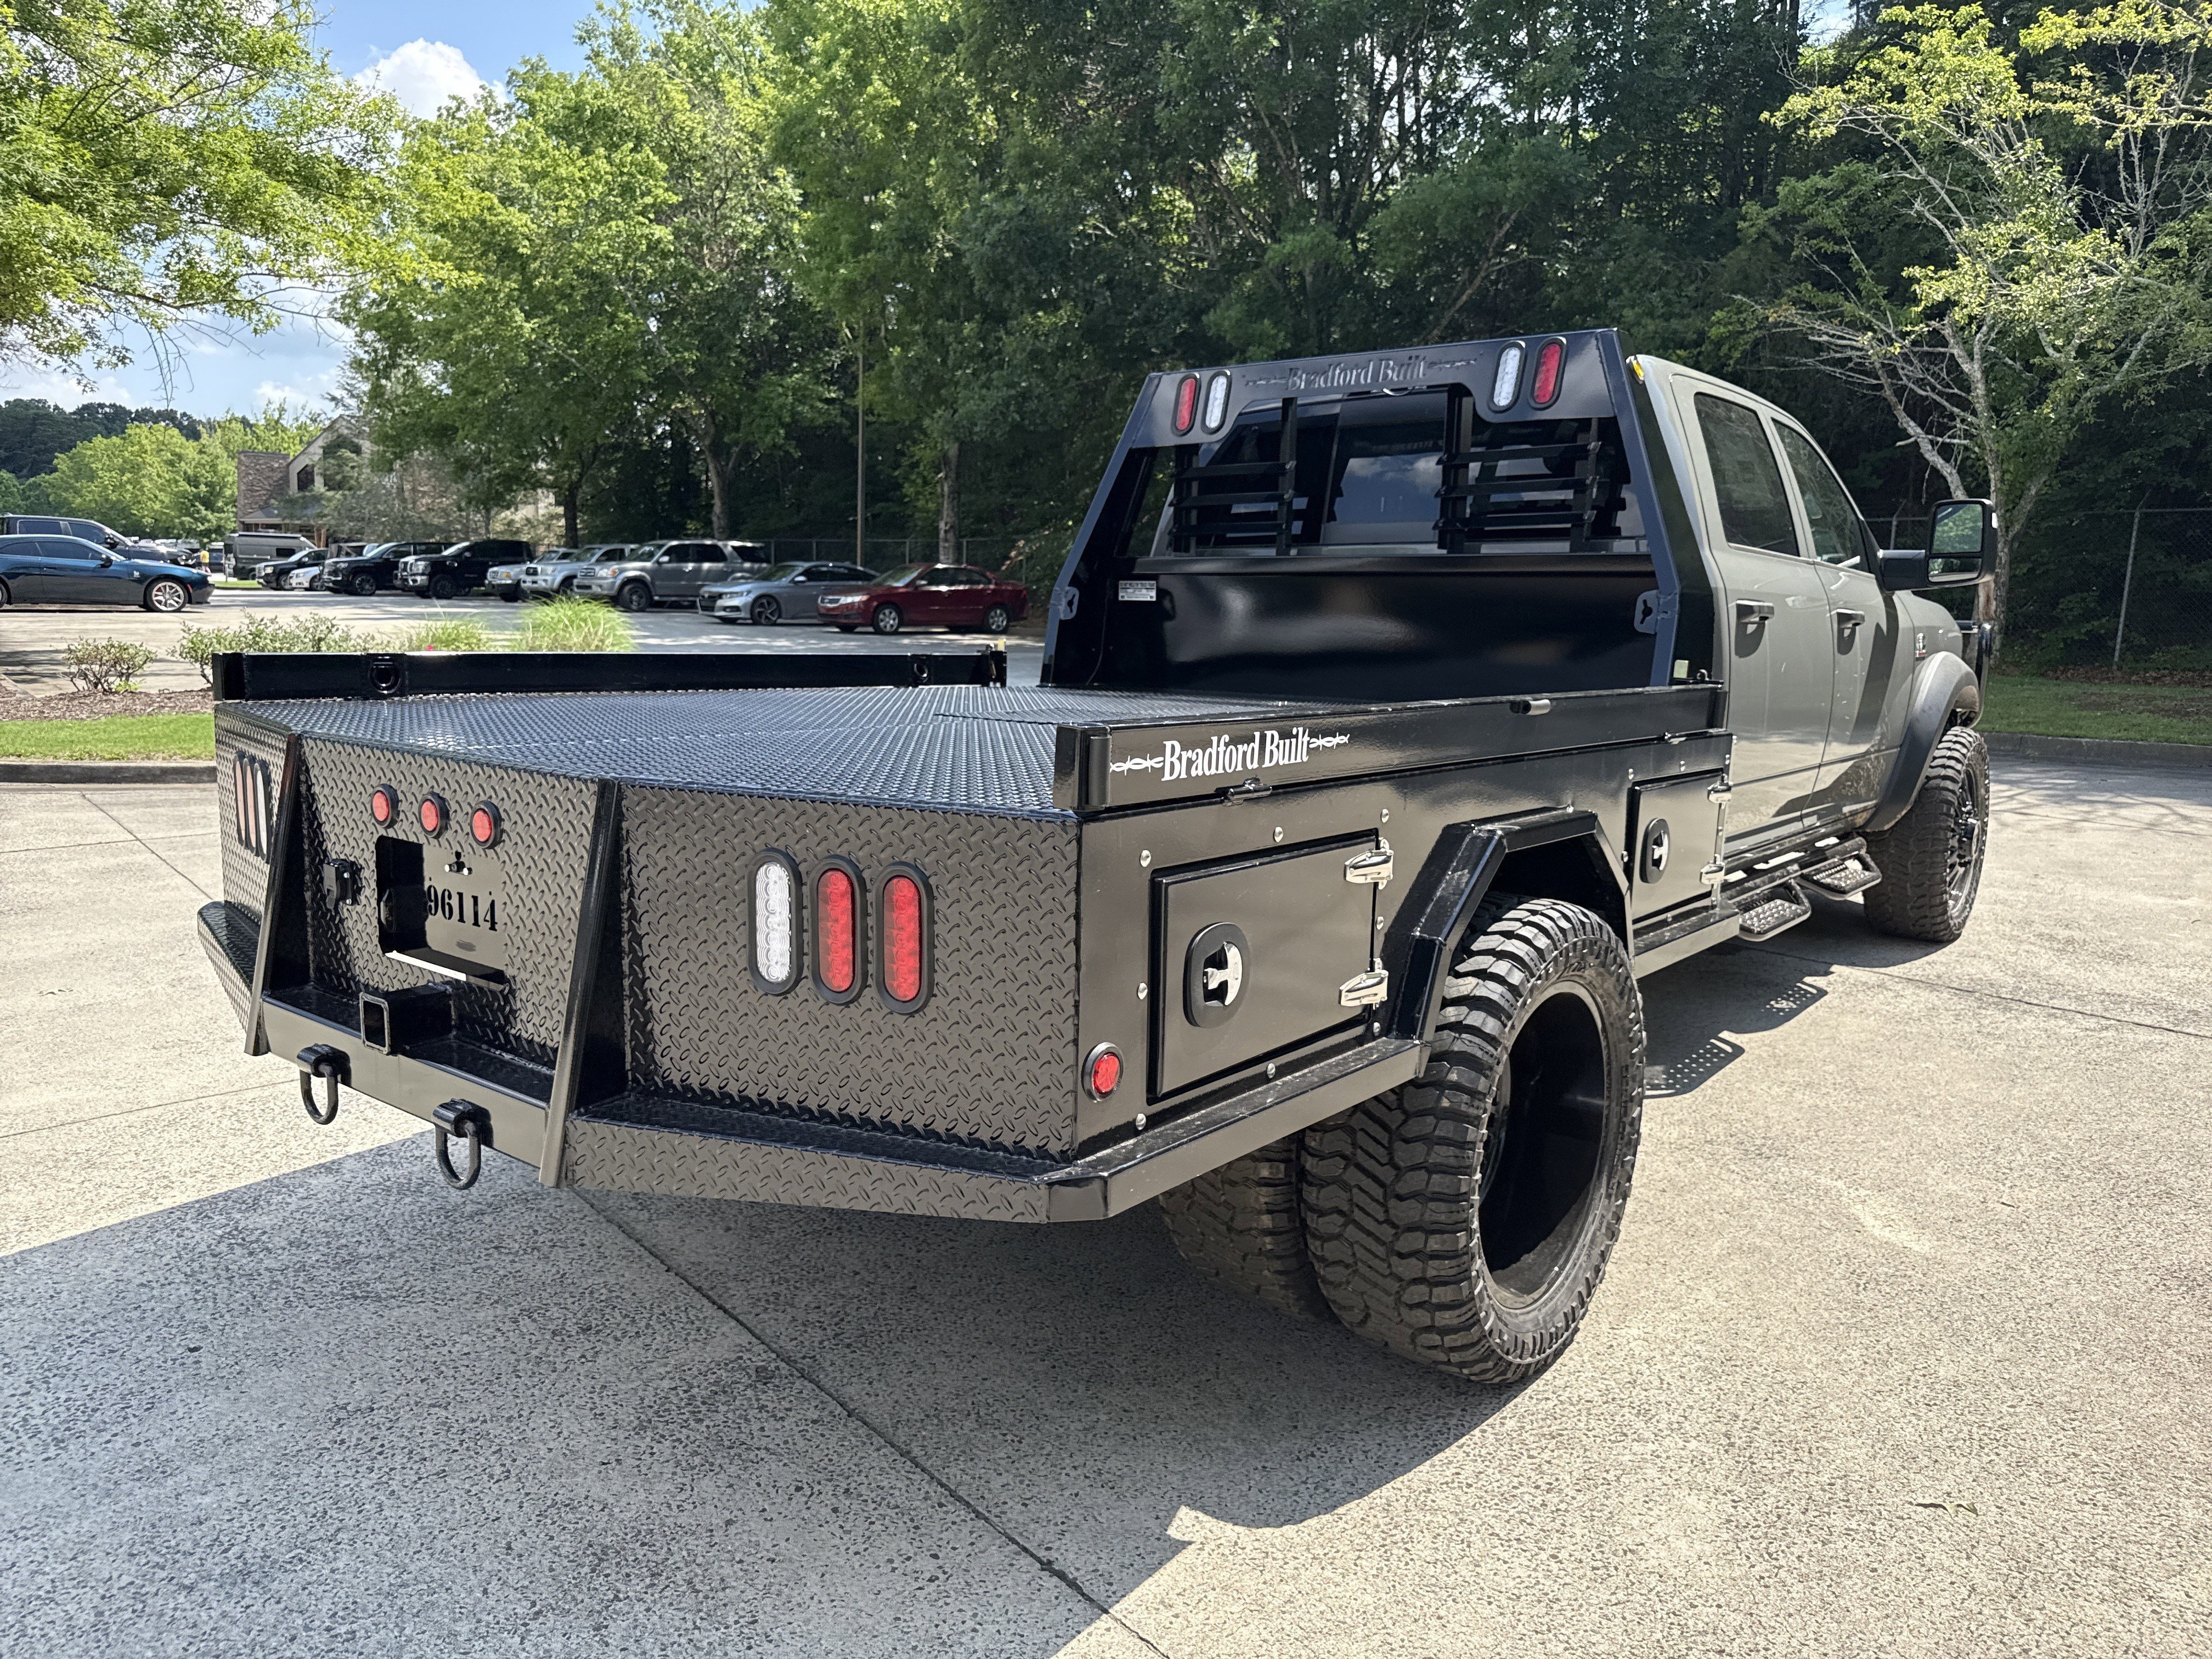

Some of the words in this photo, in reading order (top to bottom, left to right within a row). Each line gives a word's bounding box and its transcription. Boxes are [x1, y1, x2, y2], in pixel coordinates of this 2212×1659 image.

[1286, 360, 1373, 391] Bradford
[1377, 356, 1427, 383] Built
[1161, 731, 1260, 781] Bradford
[1262, 727, 1310, 768] Built
[427, 884, 498, 932] 96114
